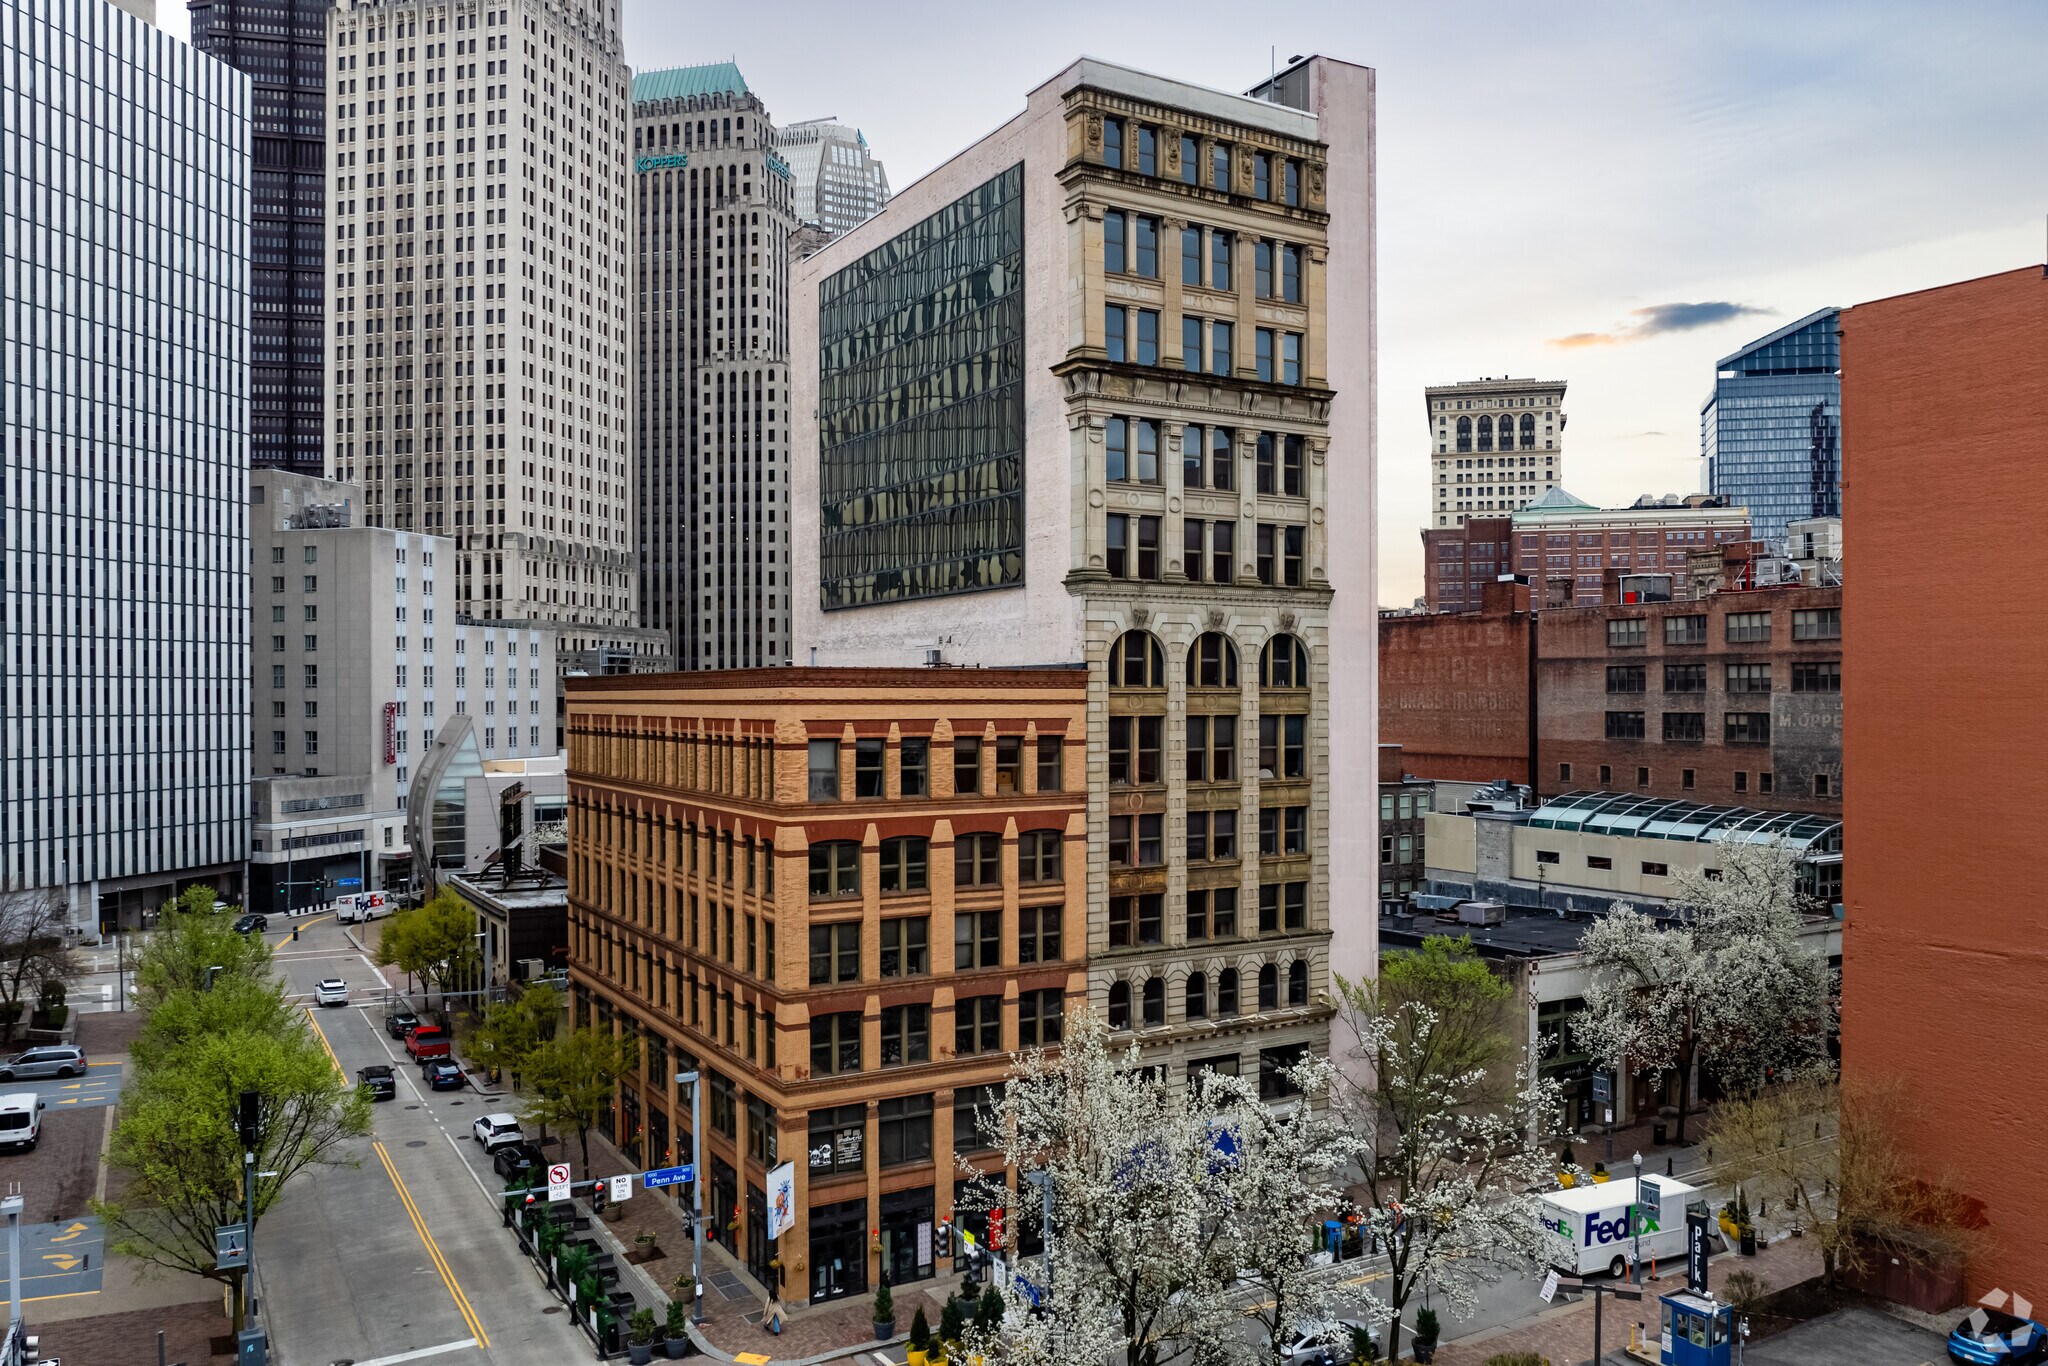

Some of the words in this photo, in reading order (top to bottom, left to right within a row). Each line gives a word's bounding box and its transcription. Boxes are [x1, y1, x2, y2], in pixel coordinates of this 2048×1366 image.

[635, 154, 688, 173] KOPPERS
[765, 153, 791, 181] KOPPERS
[651, 1177, 670, 1185] Penn
[1584, 1204, 1660, 1248] FedEx
[1694, 1224, 1703, 1283] Park
